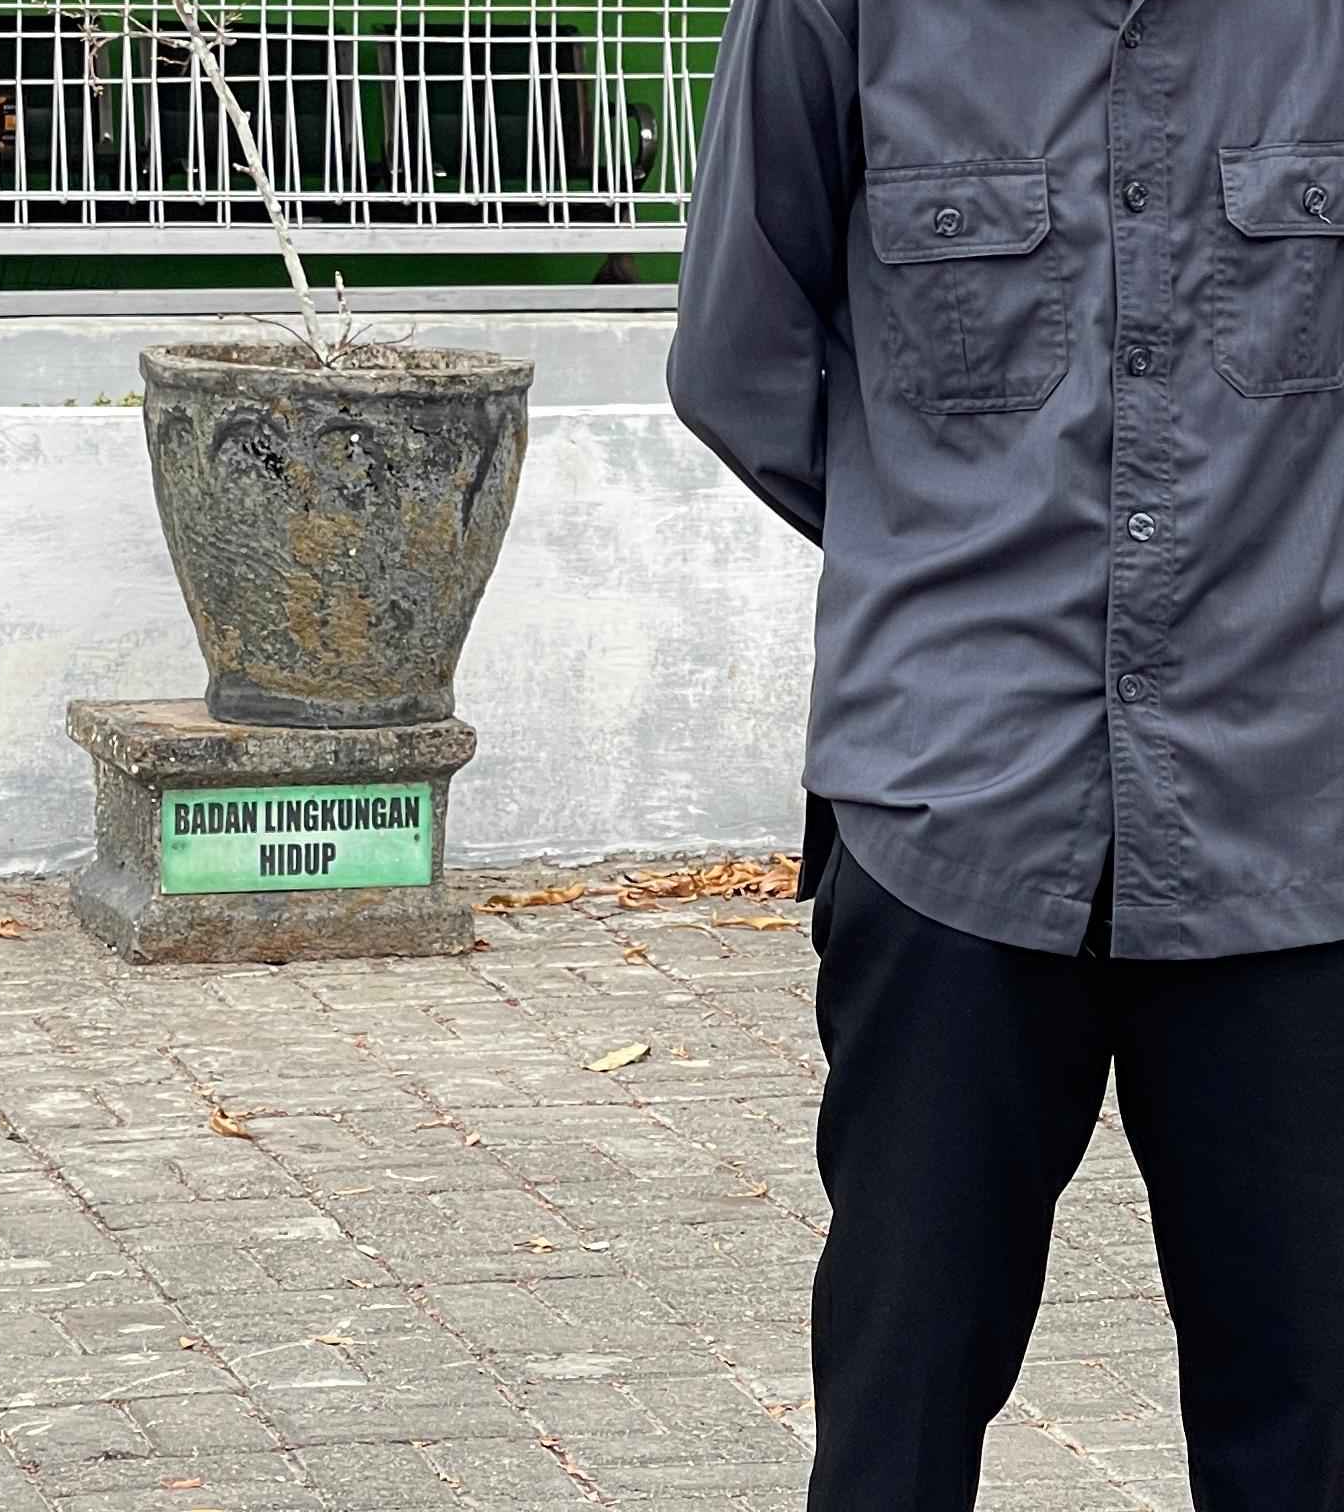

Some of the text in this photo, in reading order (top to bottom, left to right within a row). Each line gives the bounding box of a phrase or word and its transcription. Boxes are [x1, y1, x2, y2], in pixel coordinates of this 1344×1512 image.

[174, 796, 420, 836] BADAN LINGKUNGAN
[259, 842, 336, 877] HIDUP
